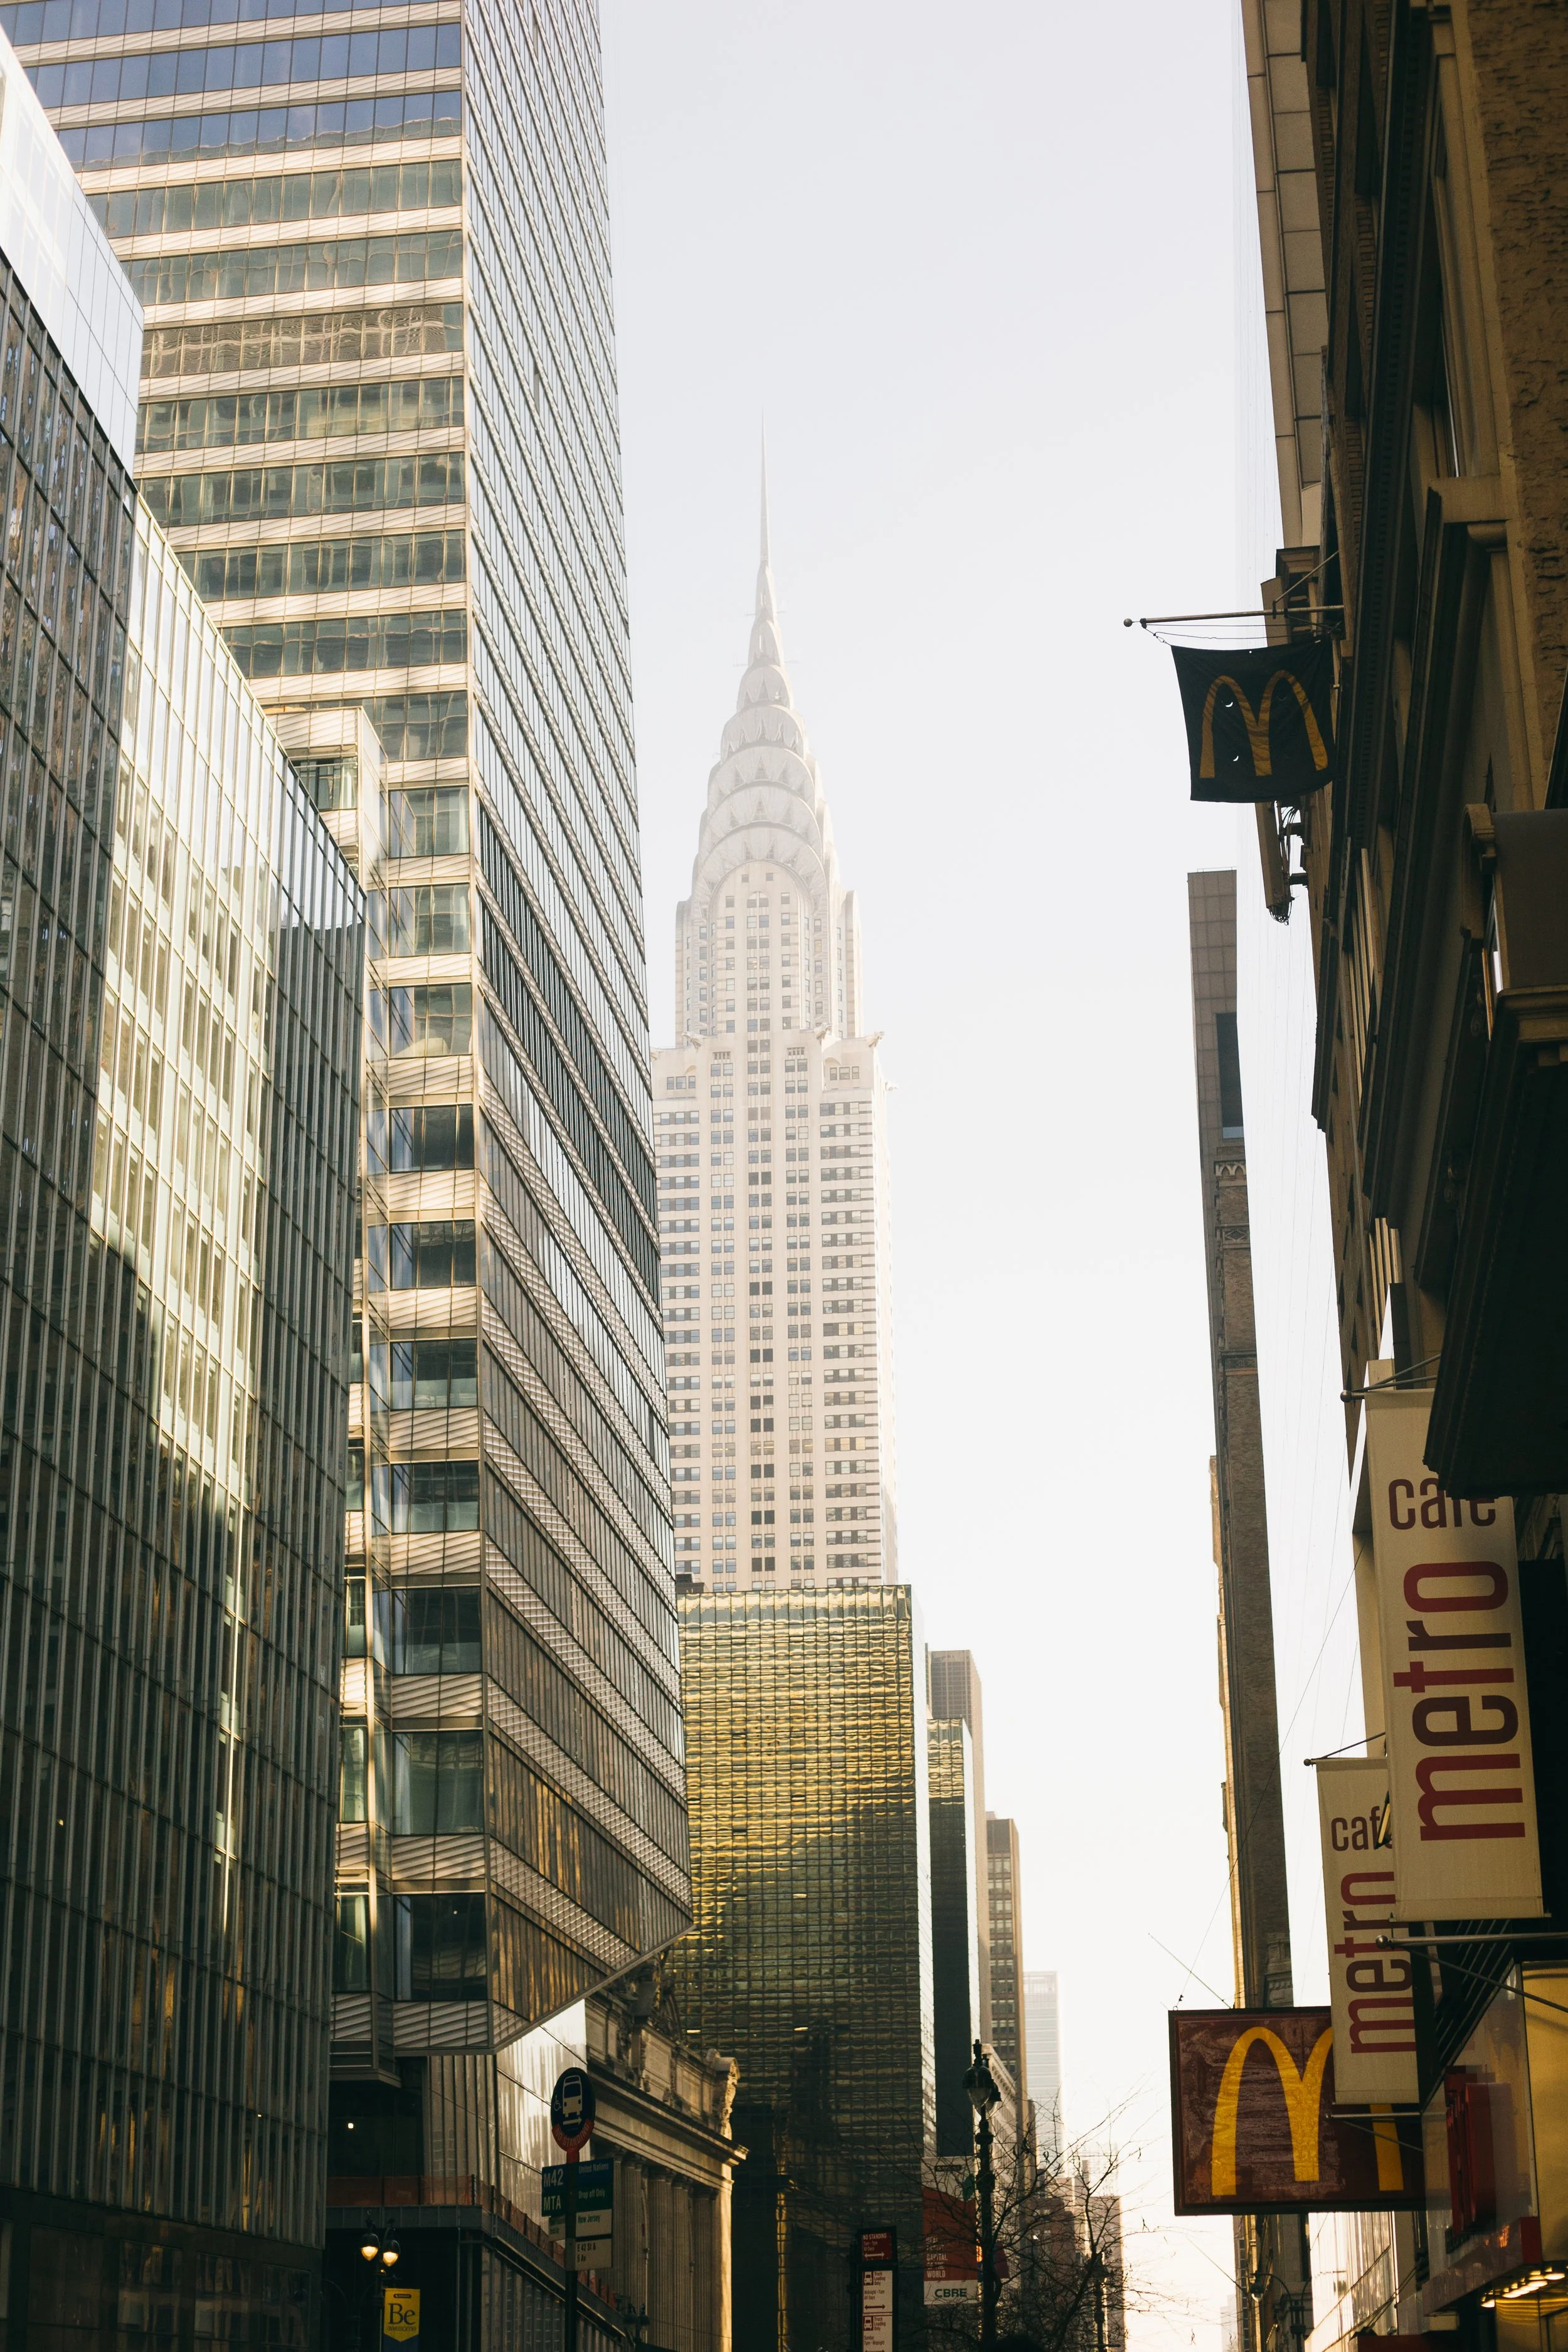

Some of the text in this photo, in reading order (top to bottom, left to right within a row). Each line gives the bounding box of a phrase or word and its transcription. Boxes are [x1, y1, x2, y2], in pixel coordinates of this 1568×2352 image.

[1392, 1560, 1526, 1841] metro
[1331, 1806, 1393, 1851] caf
[554, 2124, 590, 2148] NO STANDING
[543, 2168, 563, 2188] M42
[543, 2195, 562, 2211] MTA
[587, 2214, 600, 2223] Jersey
[581, 2243, 586, 2252] 42
[926, 2253, 948, 2261] CAPITAL
[926, 2270, 946, 2278] WORLD
[935, 2288, 967, 2298] CBRE
[388, 2302, 415, 2325] Be
